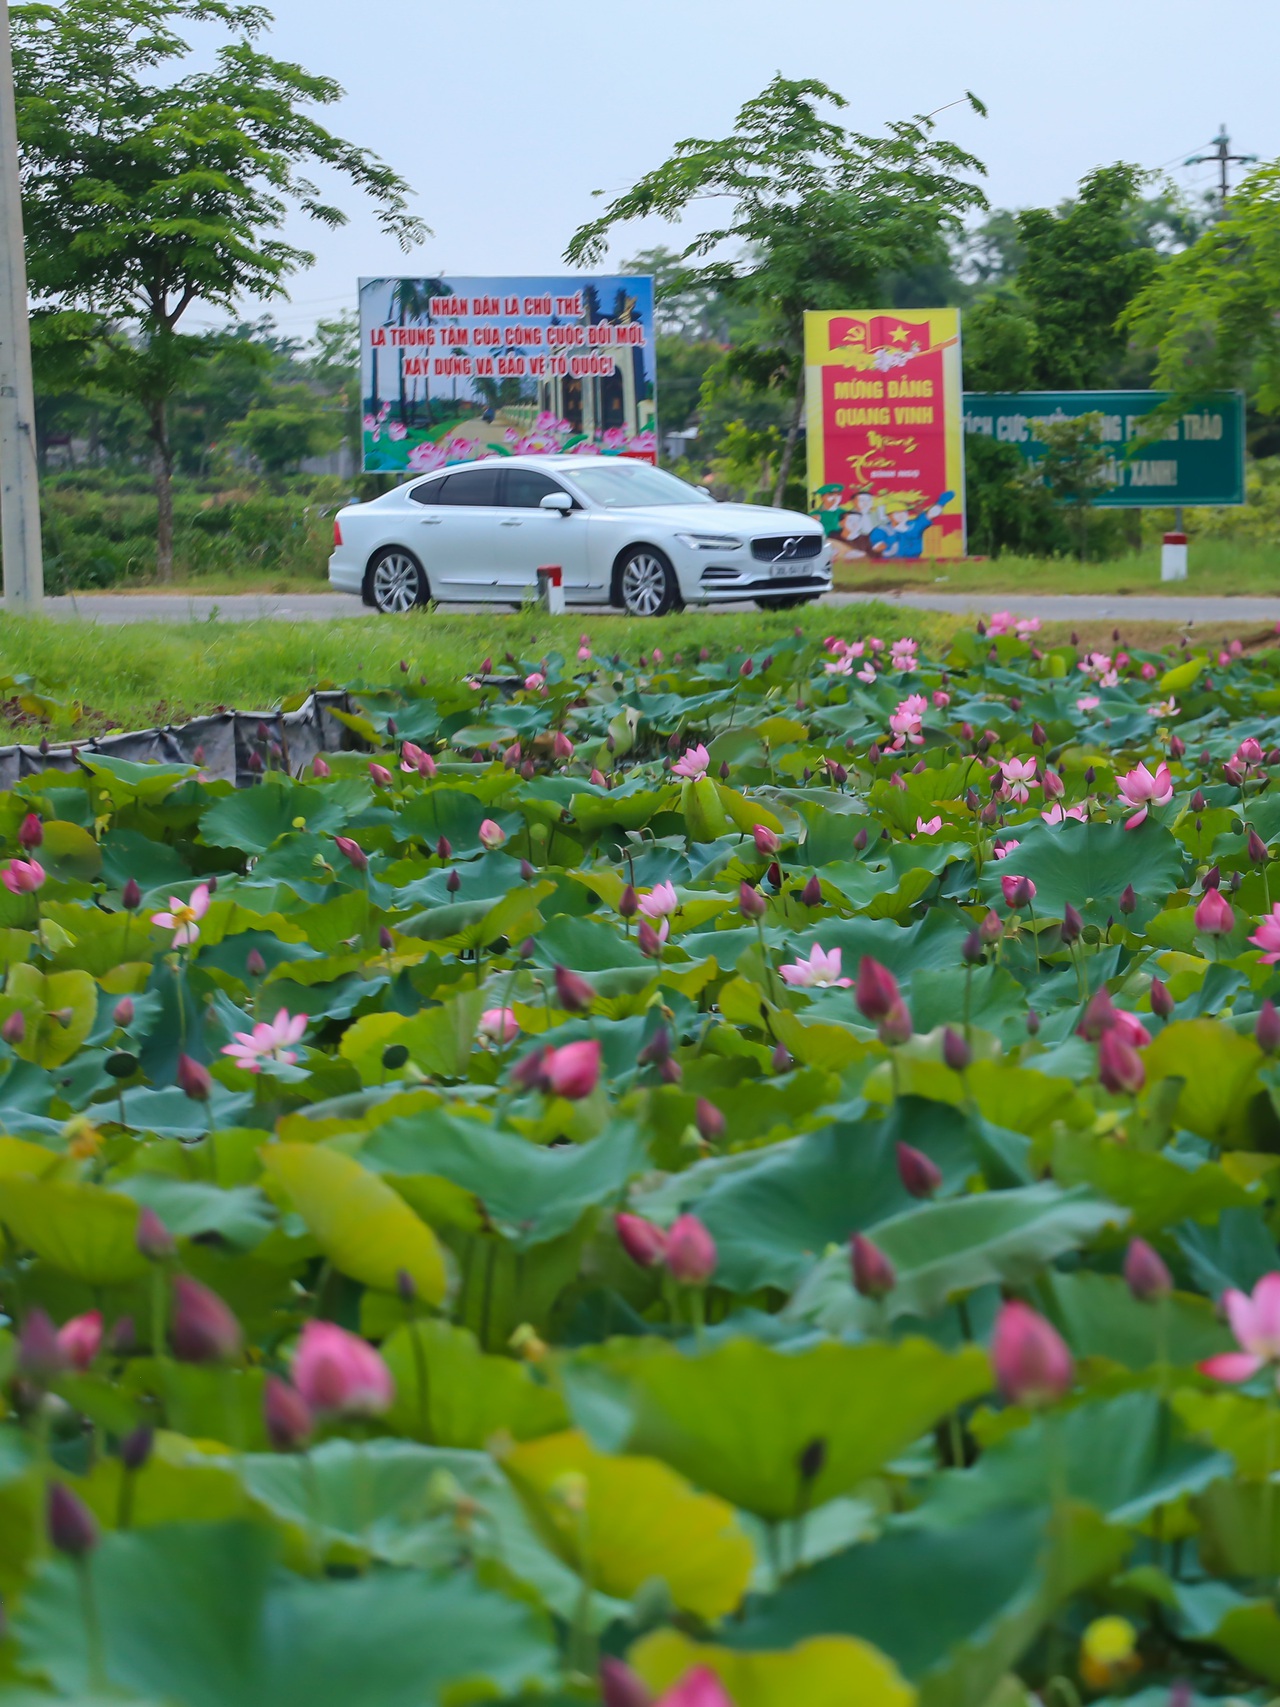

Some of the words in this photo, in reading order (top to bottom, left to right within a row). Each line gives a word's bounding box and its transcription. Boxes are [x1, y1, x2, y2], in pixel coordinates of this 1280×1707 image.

[390, 325, 435, 347] TRUNG
[887, 374, 934, 399] ĐẢNG
[835, 407, 891, 429] QUANG
[893, 406, 934, 425] VINH
